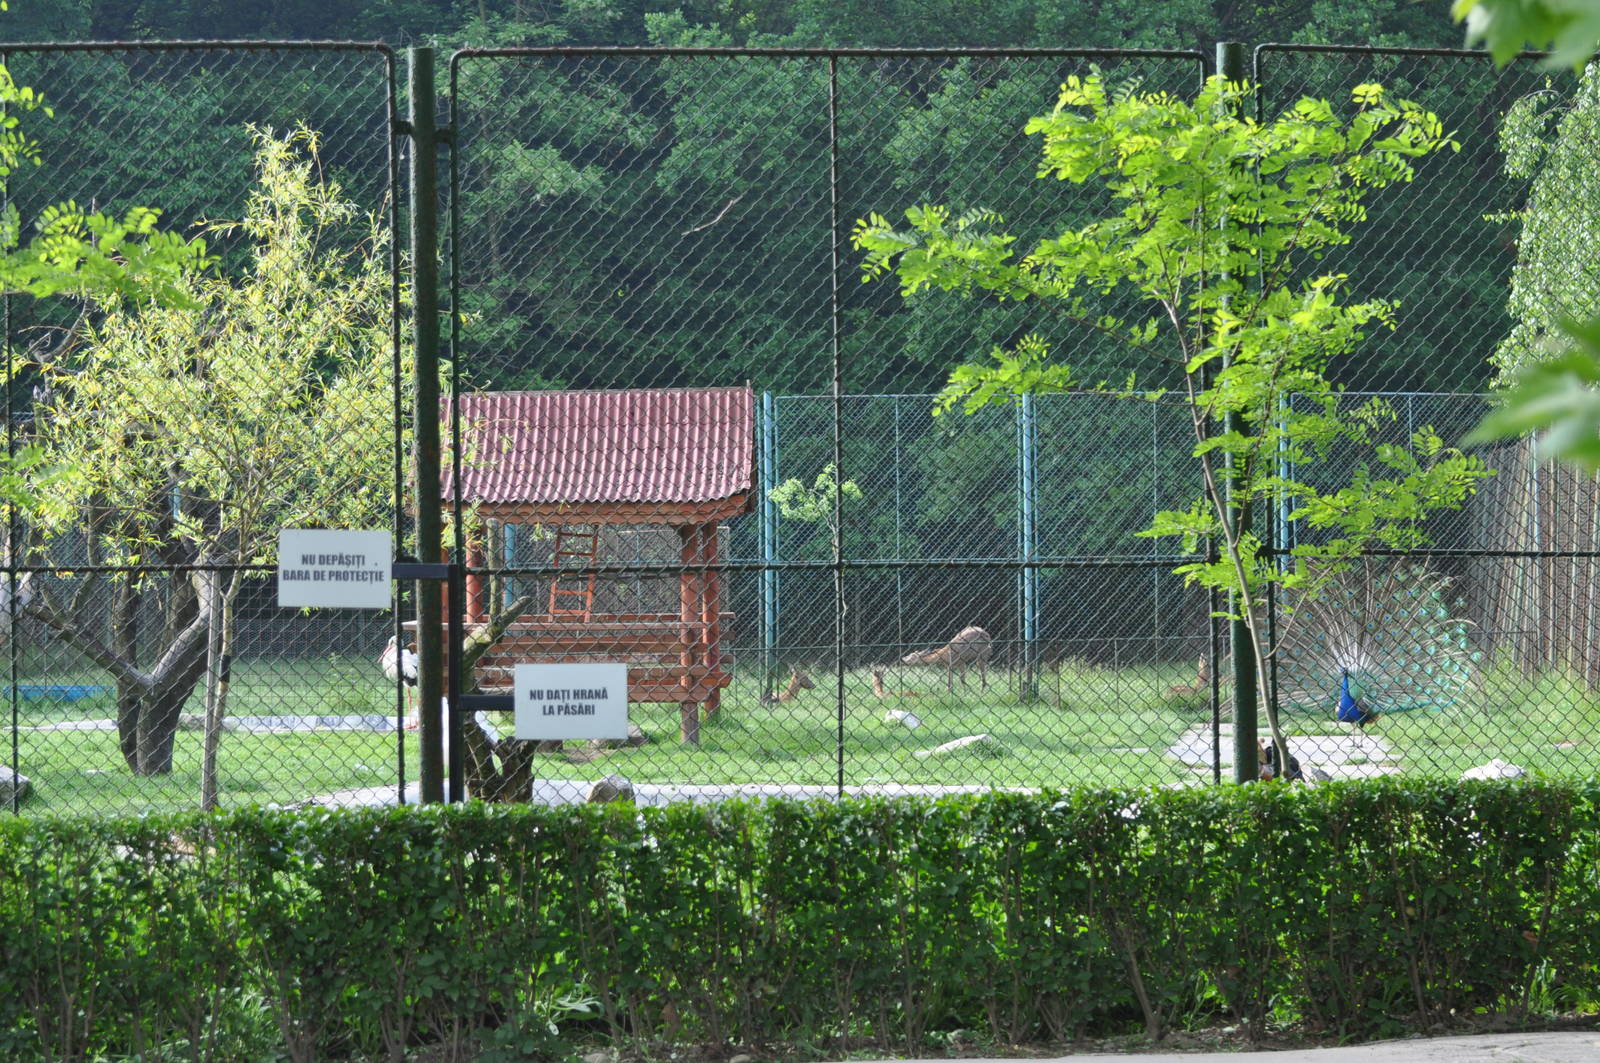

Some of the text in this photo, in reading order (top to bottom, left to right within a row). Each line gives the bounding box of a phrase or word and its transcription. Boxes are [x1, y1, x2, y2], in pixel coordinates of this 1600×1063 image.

[301, 554, 316, 566] NU
[282, 569, 385, 585] BARA DE PROTECȚIE
[529, 687, 609, 703] NU DAȚI HRANĂ
[542, 703, 596, 716] LA PĂSĂRI
